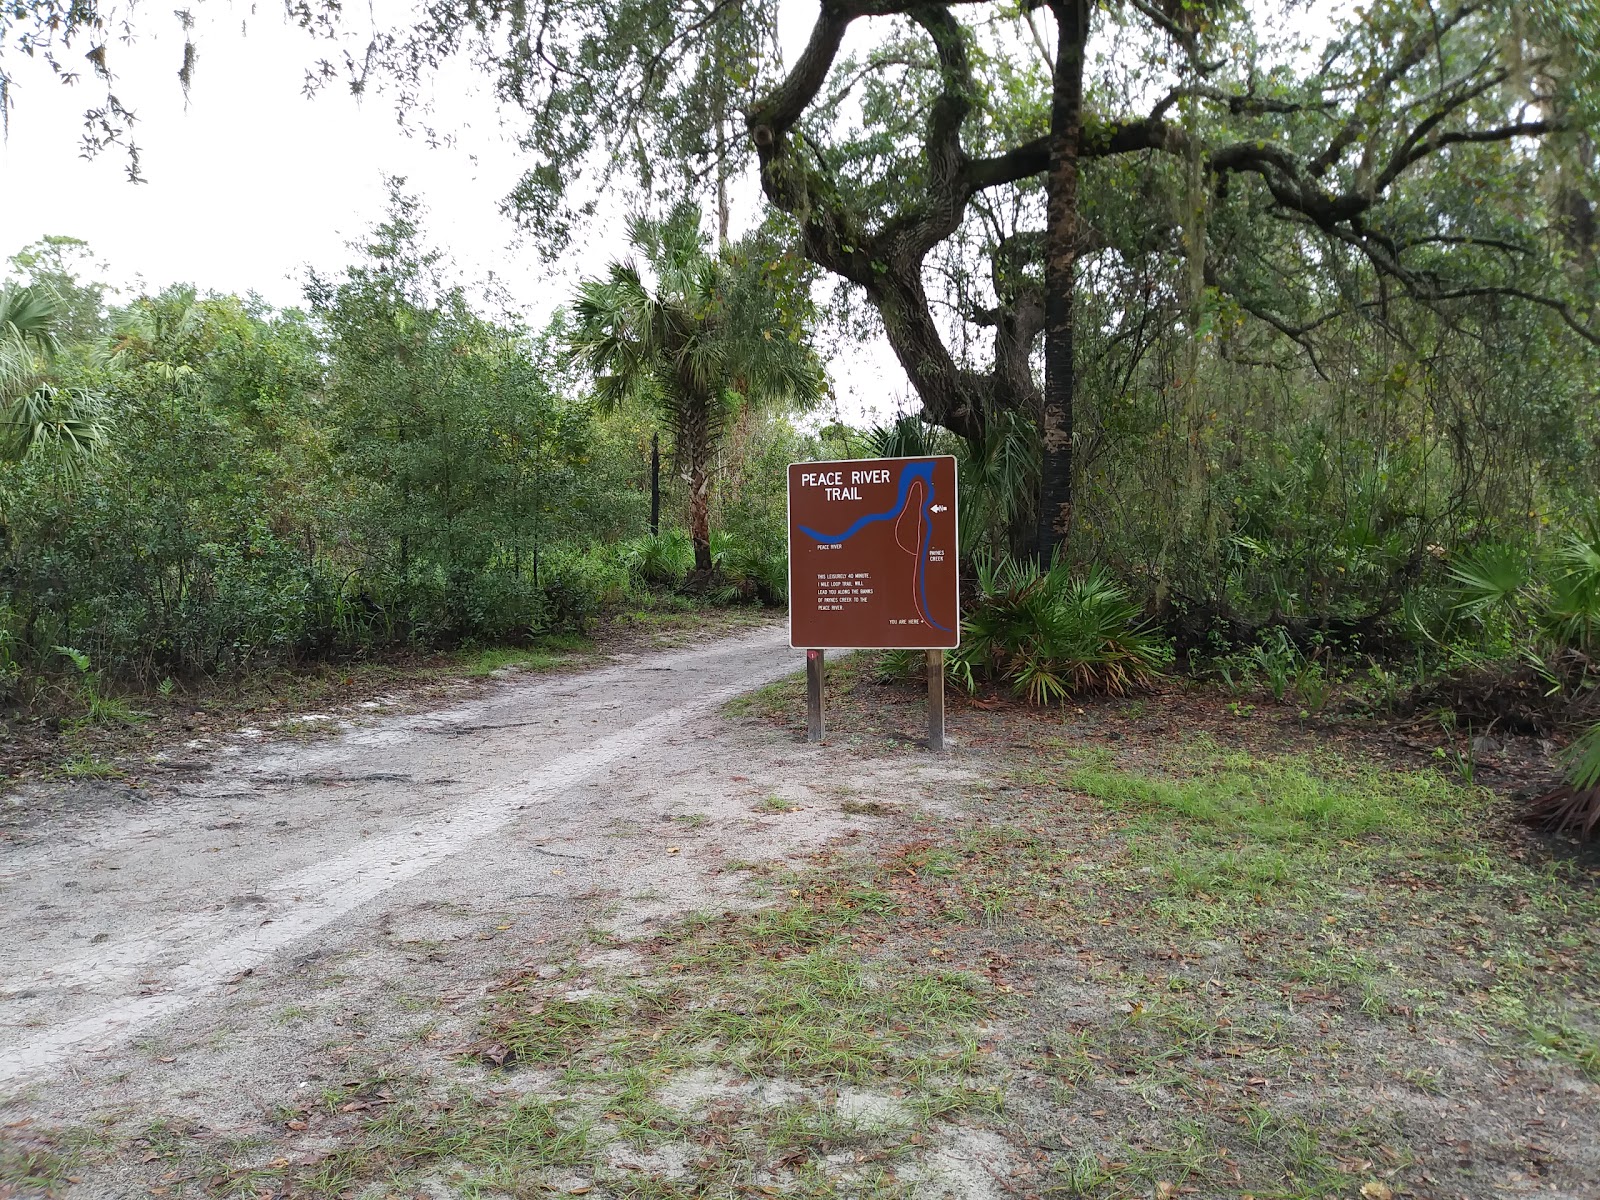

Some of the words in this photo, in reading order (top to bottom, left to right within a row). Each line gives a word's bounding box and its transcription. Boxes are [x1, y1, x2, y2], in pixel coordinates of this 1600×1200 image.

[802, 472, 842, 486] PEACE
[852, 470, 890, 484] RIVER
[825, 487, 862, 501] TRAIL
